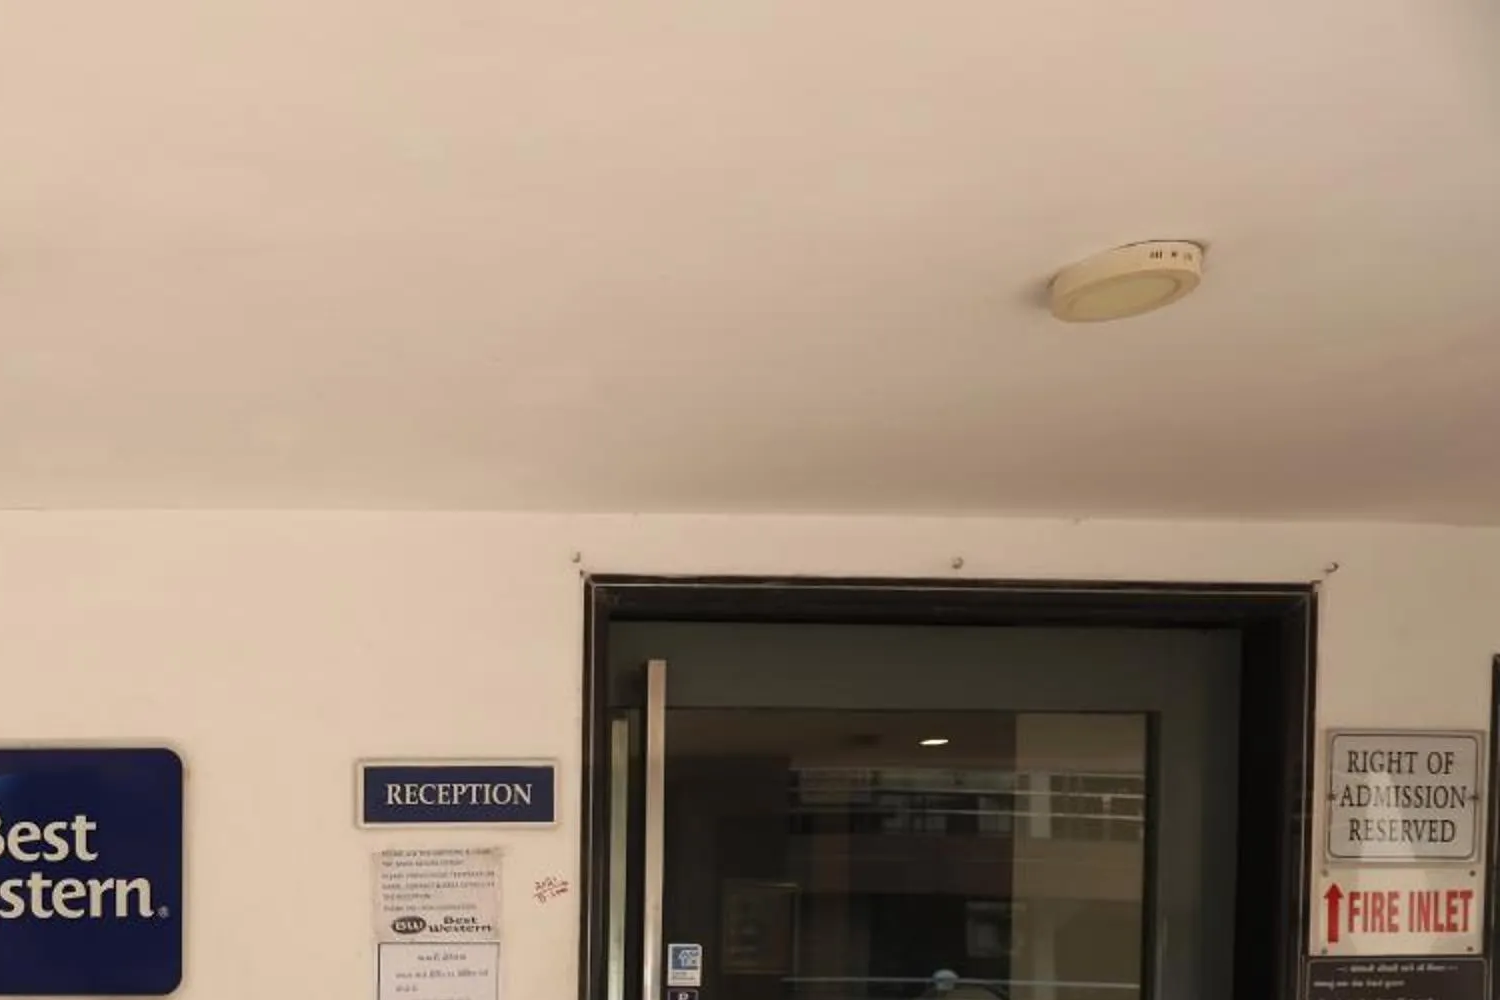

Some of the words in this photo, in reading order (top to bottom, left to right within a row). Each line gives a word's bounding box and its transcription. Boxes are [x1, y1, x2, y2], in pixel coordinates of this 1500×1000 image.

[1347, 749, 1418, 774] RIGHT
[1426, 751, 1456, 775] OF
[386, 783, 534, 806] RECEPTION
[1339, 784, 1468, 810] ADMISSION
[1347, 818, 1457, 844] RESERVED
[1347, 890, 1399, 933] FIRE
[1408, 889, 1474, 933] INLET
